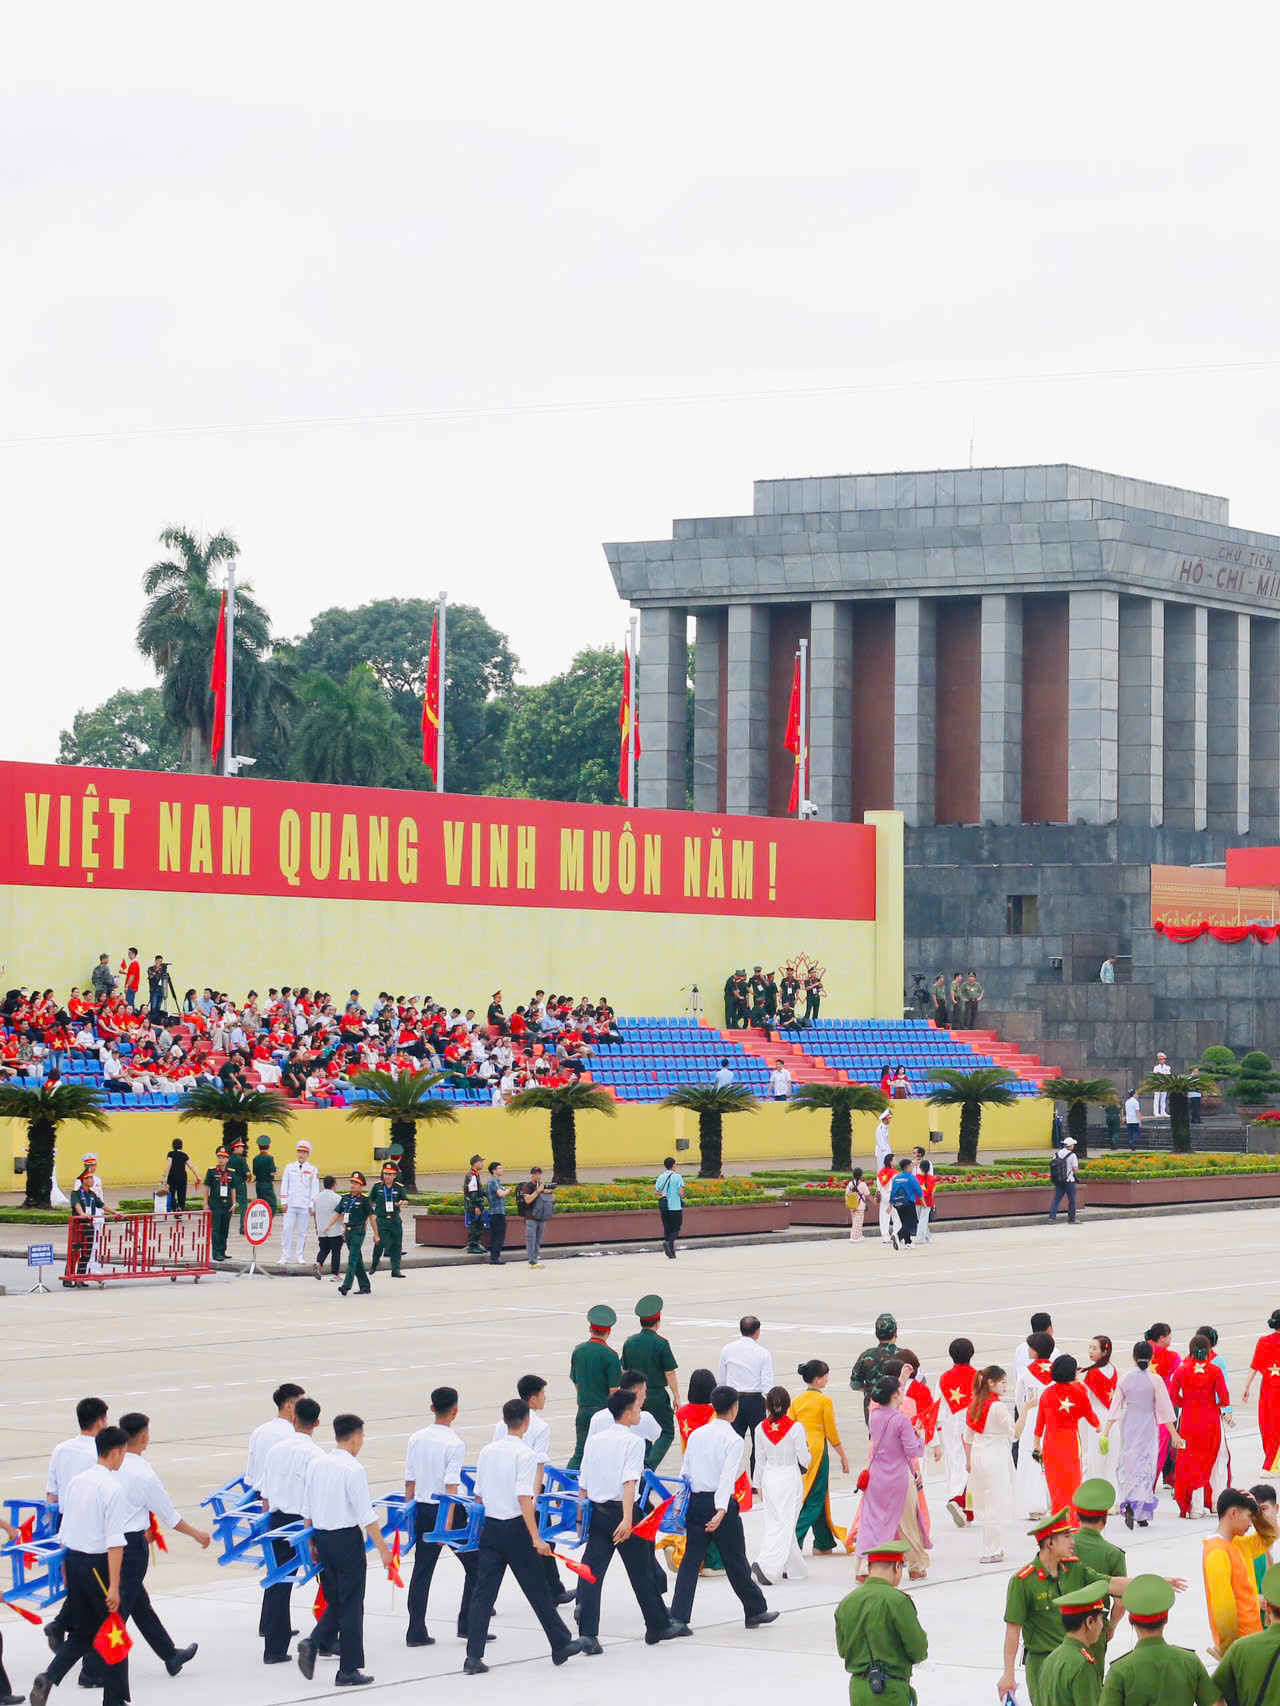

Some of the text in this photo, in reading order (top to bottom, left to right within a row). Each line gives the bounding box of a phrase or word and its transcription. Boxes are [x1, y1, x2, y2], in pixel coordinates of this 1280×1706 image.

[24, 783, 130, 882] VIỆT
[159, 801, 251, 876] NAM
[279, 808, 418, 886] QUANG
[443, 820, 536, 889] VINH
[560, 821, 661, 895] MUÔN
